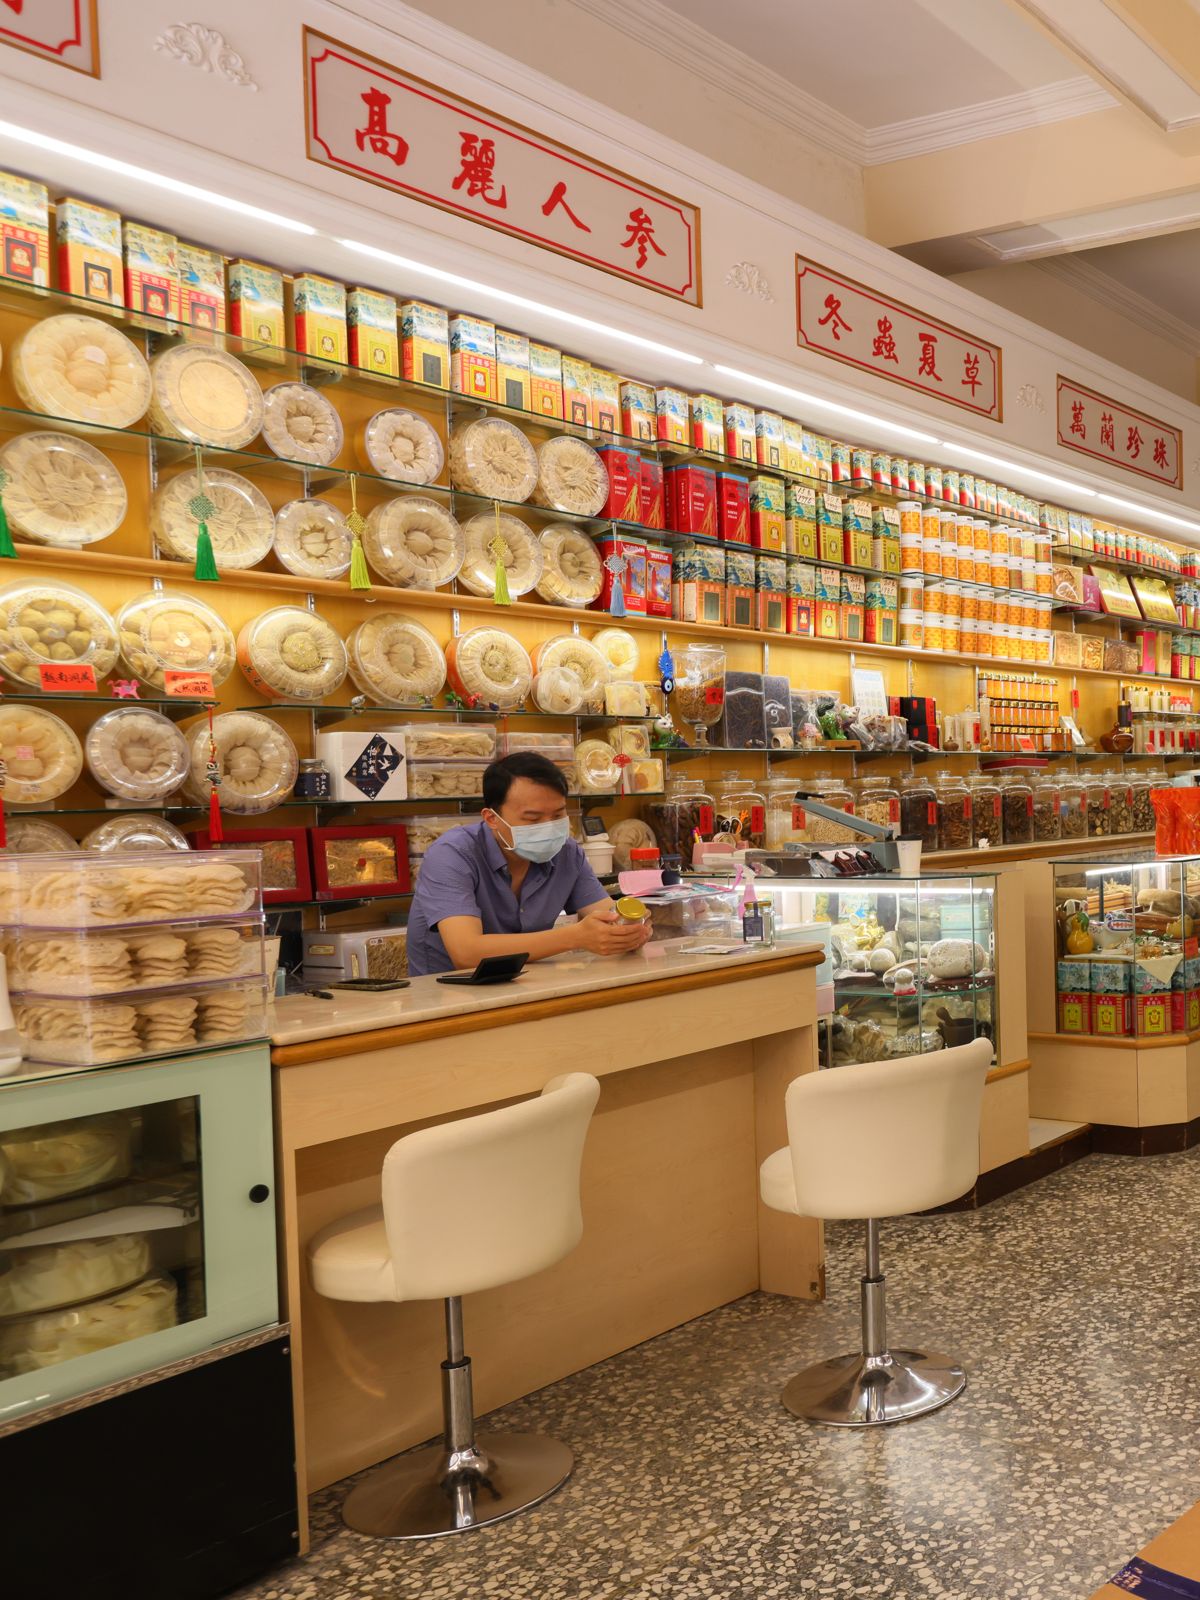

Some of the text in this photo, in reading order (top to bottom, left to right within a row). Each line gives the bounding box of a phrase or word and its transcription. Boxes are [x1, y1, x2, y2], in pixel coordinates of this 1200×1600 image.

[818, 293, 982, 397] 冬蟲夏草
[1069, 400, 1170, 470] 萬蘭珍珠
